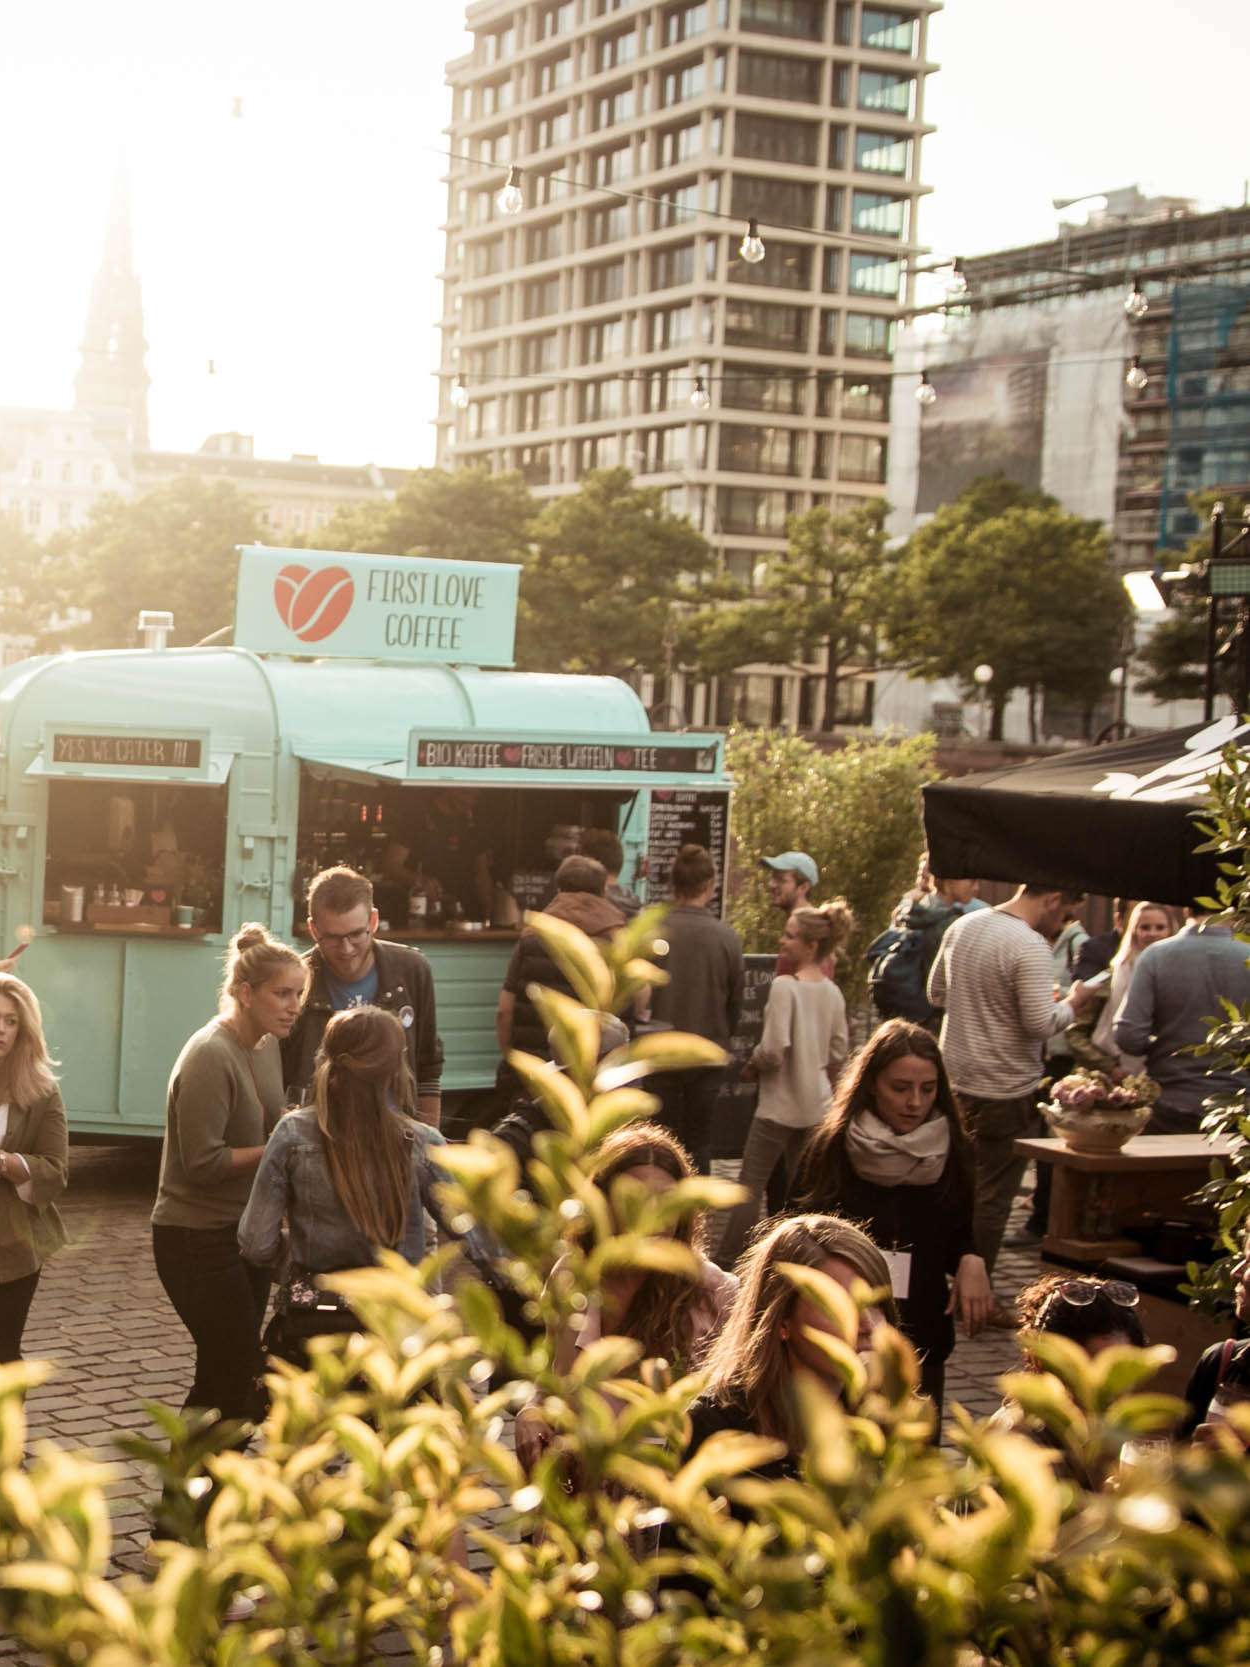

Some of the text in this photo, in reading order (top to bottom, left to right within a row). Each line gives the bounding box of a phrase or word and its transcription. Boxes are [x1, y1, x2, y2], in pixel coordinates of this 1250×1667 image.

[367, 569, 487, 610] FIRST LOVE
[385, 613, 465, 650] COFFEE
[59, 737, 86, 761] YES
[91, 738, 113, 762] WE
[115, 739, 165, 762] CATER
[426, 743, 451, 766] BIO
[455, 743, 502, 767] KAFFEE
[635, 748, 657, 769] TEE
